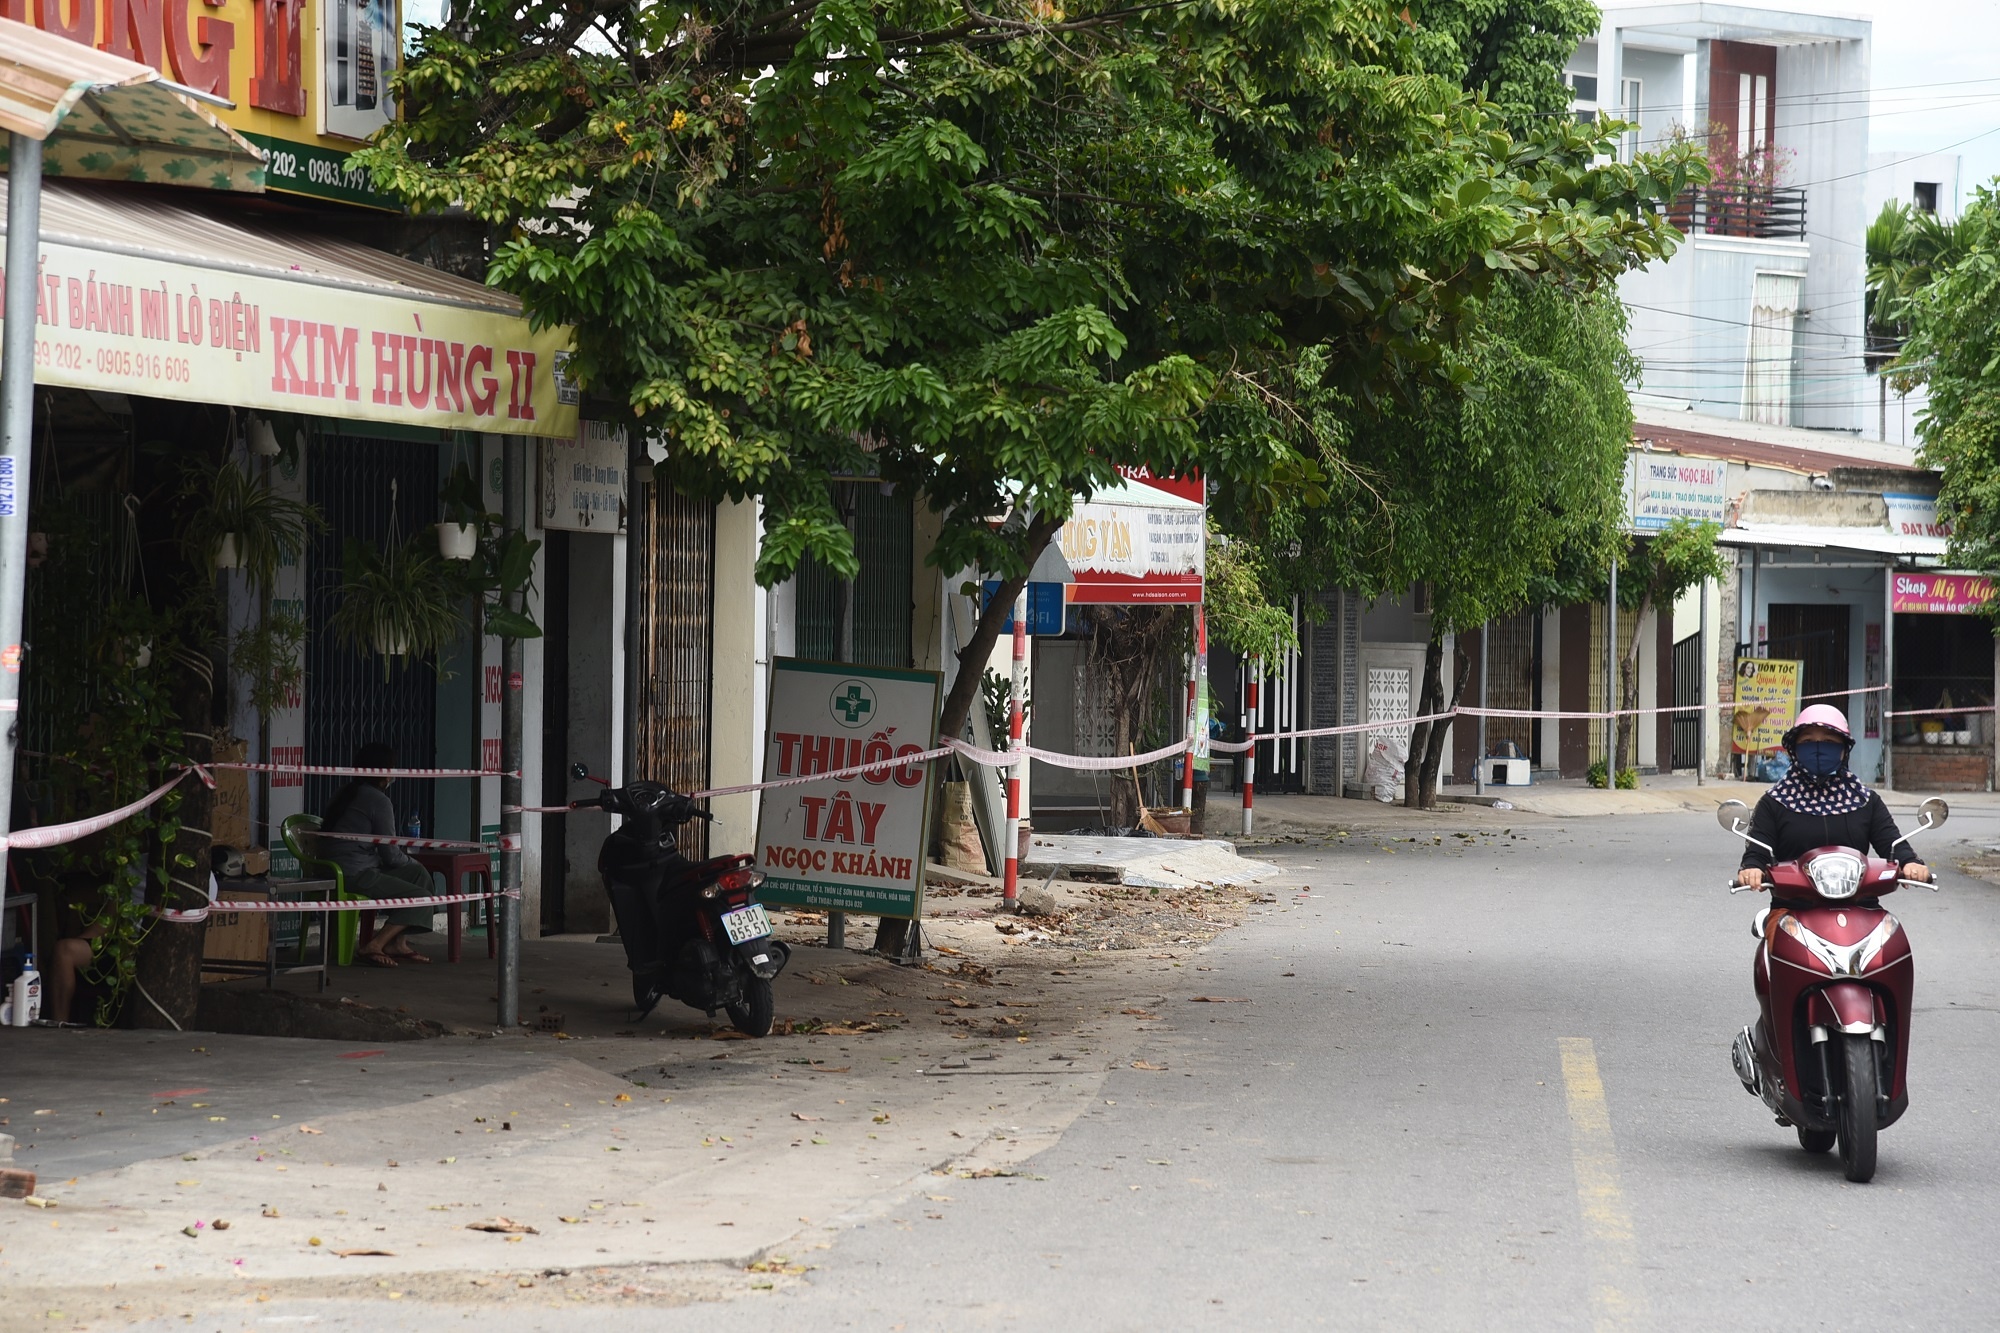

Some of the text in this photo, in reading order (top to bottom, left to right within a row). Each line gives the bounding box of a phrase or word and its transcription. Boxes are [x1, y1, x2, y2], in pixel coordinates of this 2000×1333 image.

[273, 150, 297, 179] 202
[68, 269, 135, 337] BÁNH
[141, 280, 171, 342] MÌ
[176, 283, 203, 347] LÒ
[208, 291, 261, 363] ĐIỆN
[55, 342, 82, 371] 202
[97, 347, 161, 381] 0905.916
[165, 356, 191, 384] 606
[269, 315, 361, 402] KIM
[371, 312, 500, 418] HÙNG
[506, 348, 538, 421] II
[1650, 464, 1666, 479] TRANG
[1678, 467, 1699, 487] NGỌC
[1896, 576, 1927, 598] Shop
[1930, 600, 1944, 612] BÁN
[1946, 600, 1957, 612] ÁO
[1757, 661, 1776, 673] UỐN
[773, 726, 925, 789] THUỐC
[799, 790, 887, 846] TÂY
[764, 845, 913, 880] NGỌC KHÁNH
[729, 908, 759, 927] 43-D1
